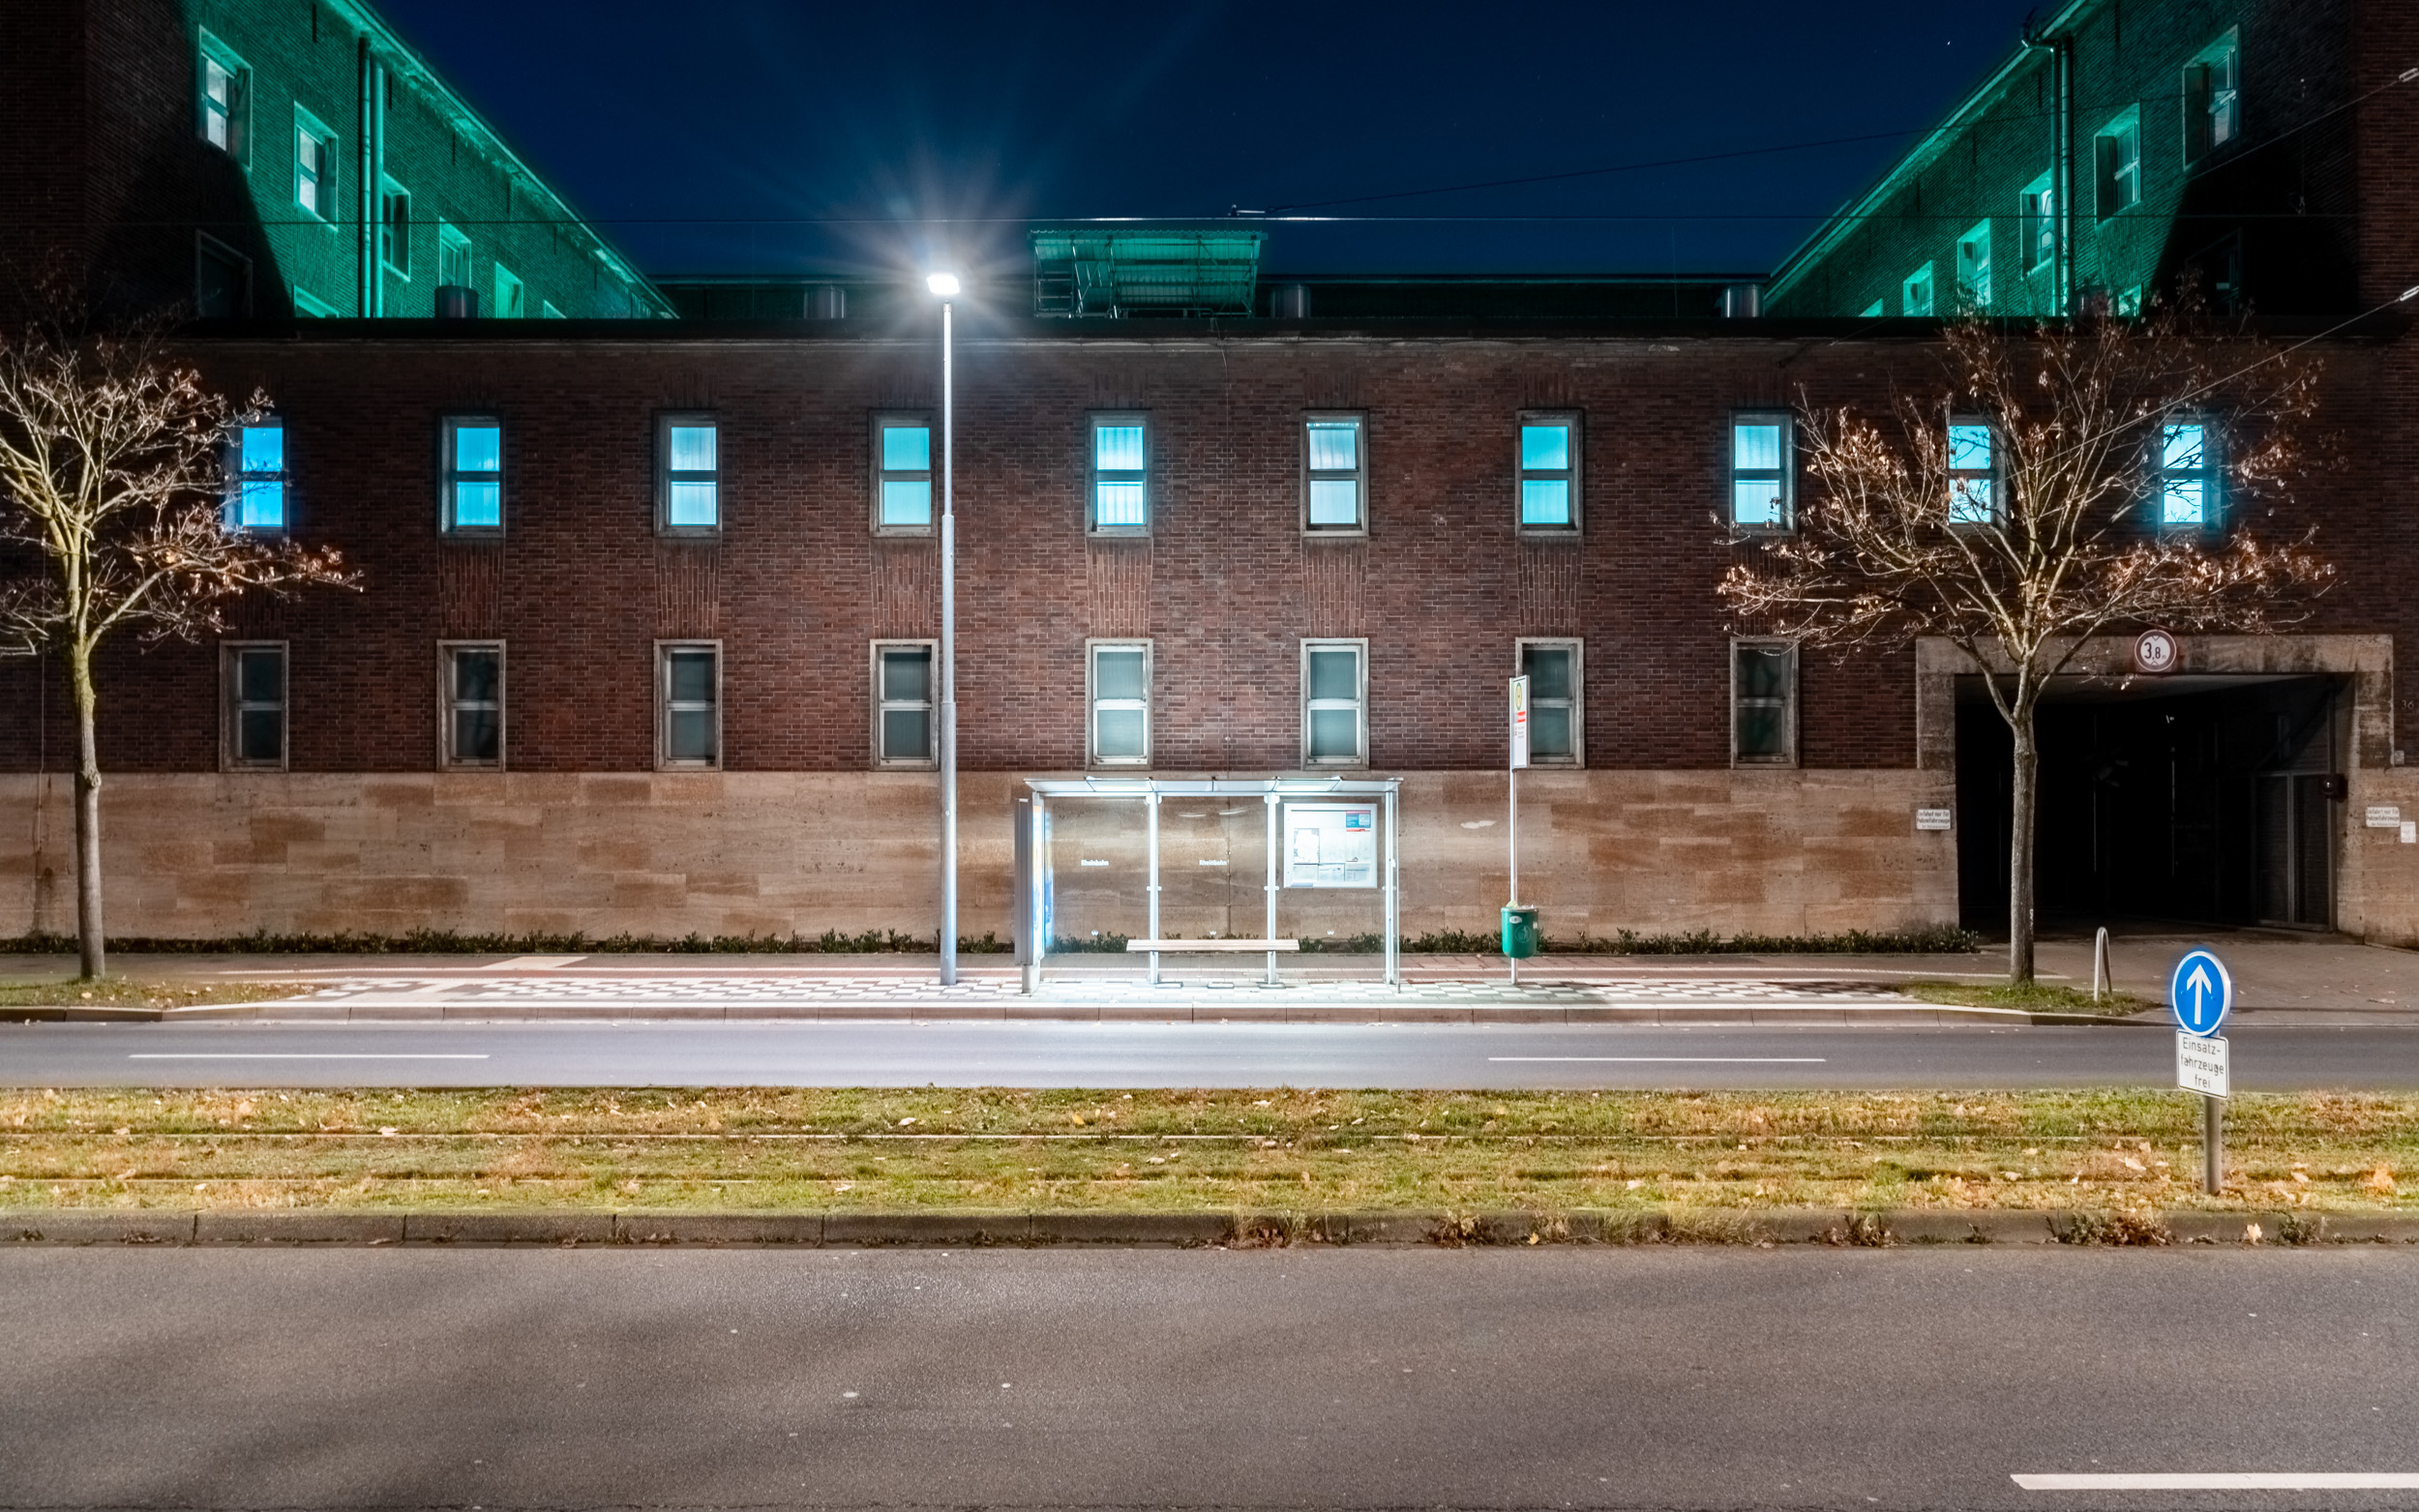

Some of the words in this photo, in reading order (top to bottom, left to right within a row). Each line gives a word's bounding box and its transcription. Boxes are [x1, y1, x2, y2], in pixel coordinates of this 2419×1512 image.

[2401, 699, 2414, 710] 36
[2183, 1037, 2221, 1054] Einsatz-
[2181, 1053, 2224, 1076] fahrzeuge
[2195, 1074, 2211, 1089] frei
